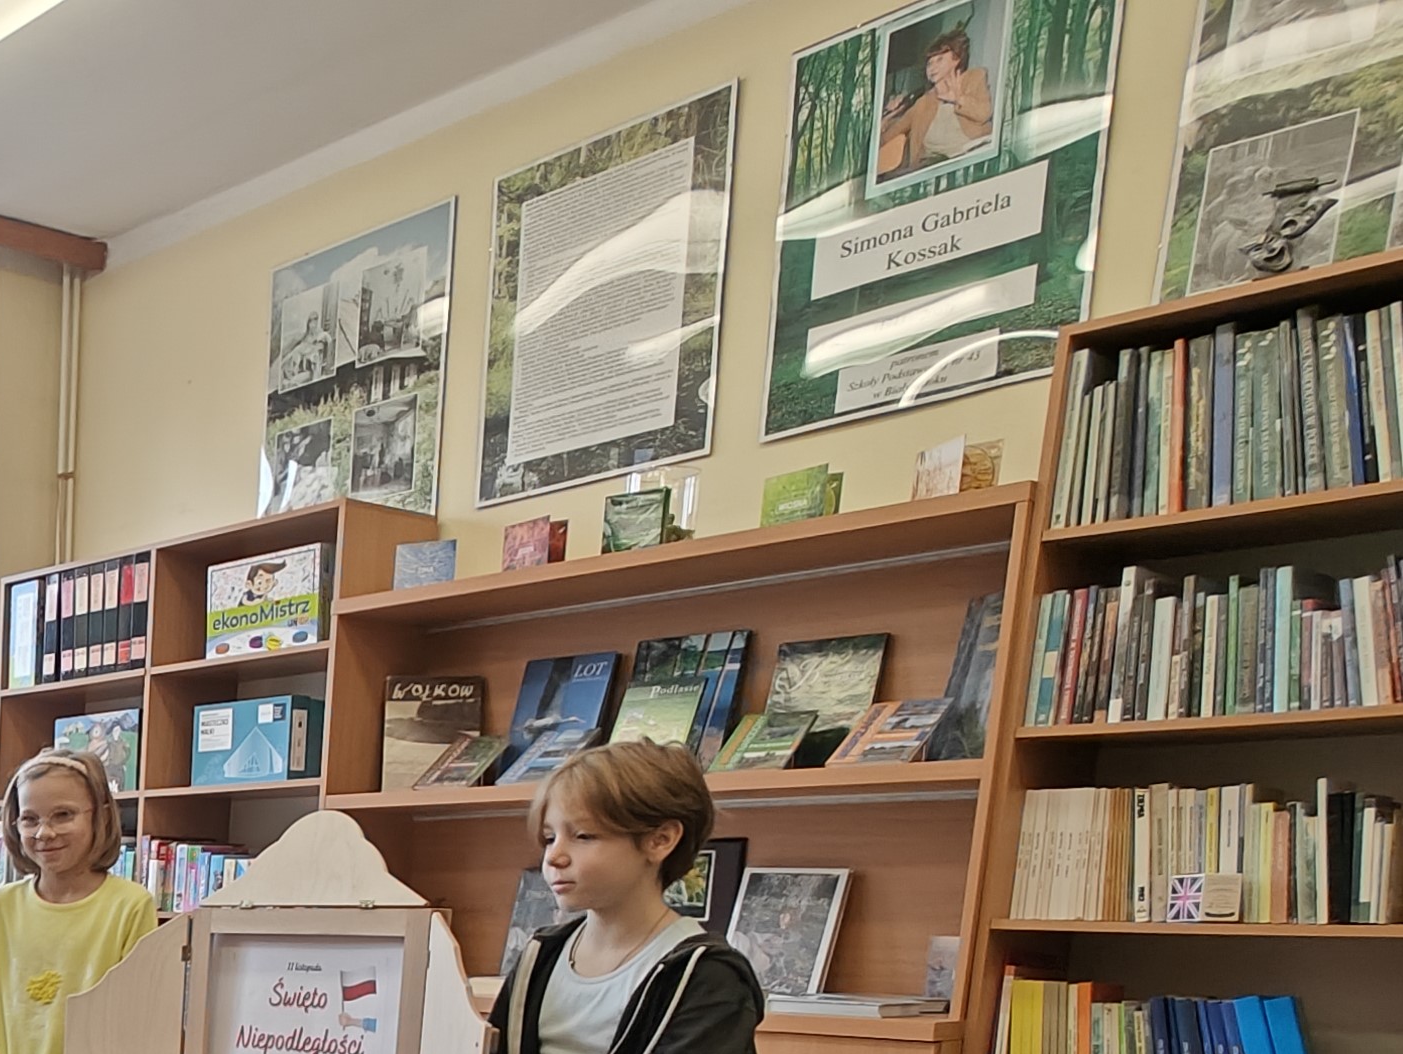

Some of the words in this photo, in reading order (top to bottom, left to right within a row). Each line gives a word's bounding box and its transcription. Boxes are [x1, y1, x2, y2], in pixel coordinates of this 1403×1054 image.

[839, 225, 914, 259] Simona
[921, 192, 1012, 233] Gabriela
[885, 233, 964, 271] Kossak
[212, 599, 310, 631] ekonoMistrz
[573, 660, 609, 678] LOT
[268, 976, 329, 1014] Święto
